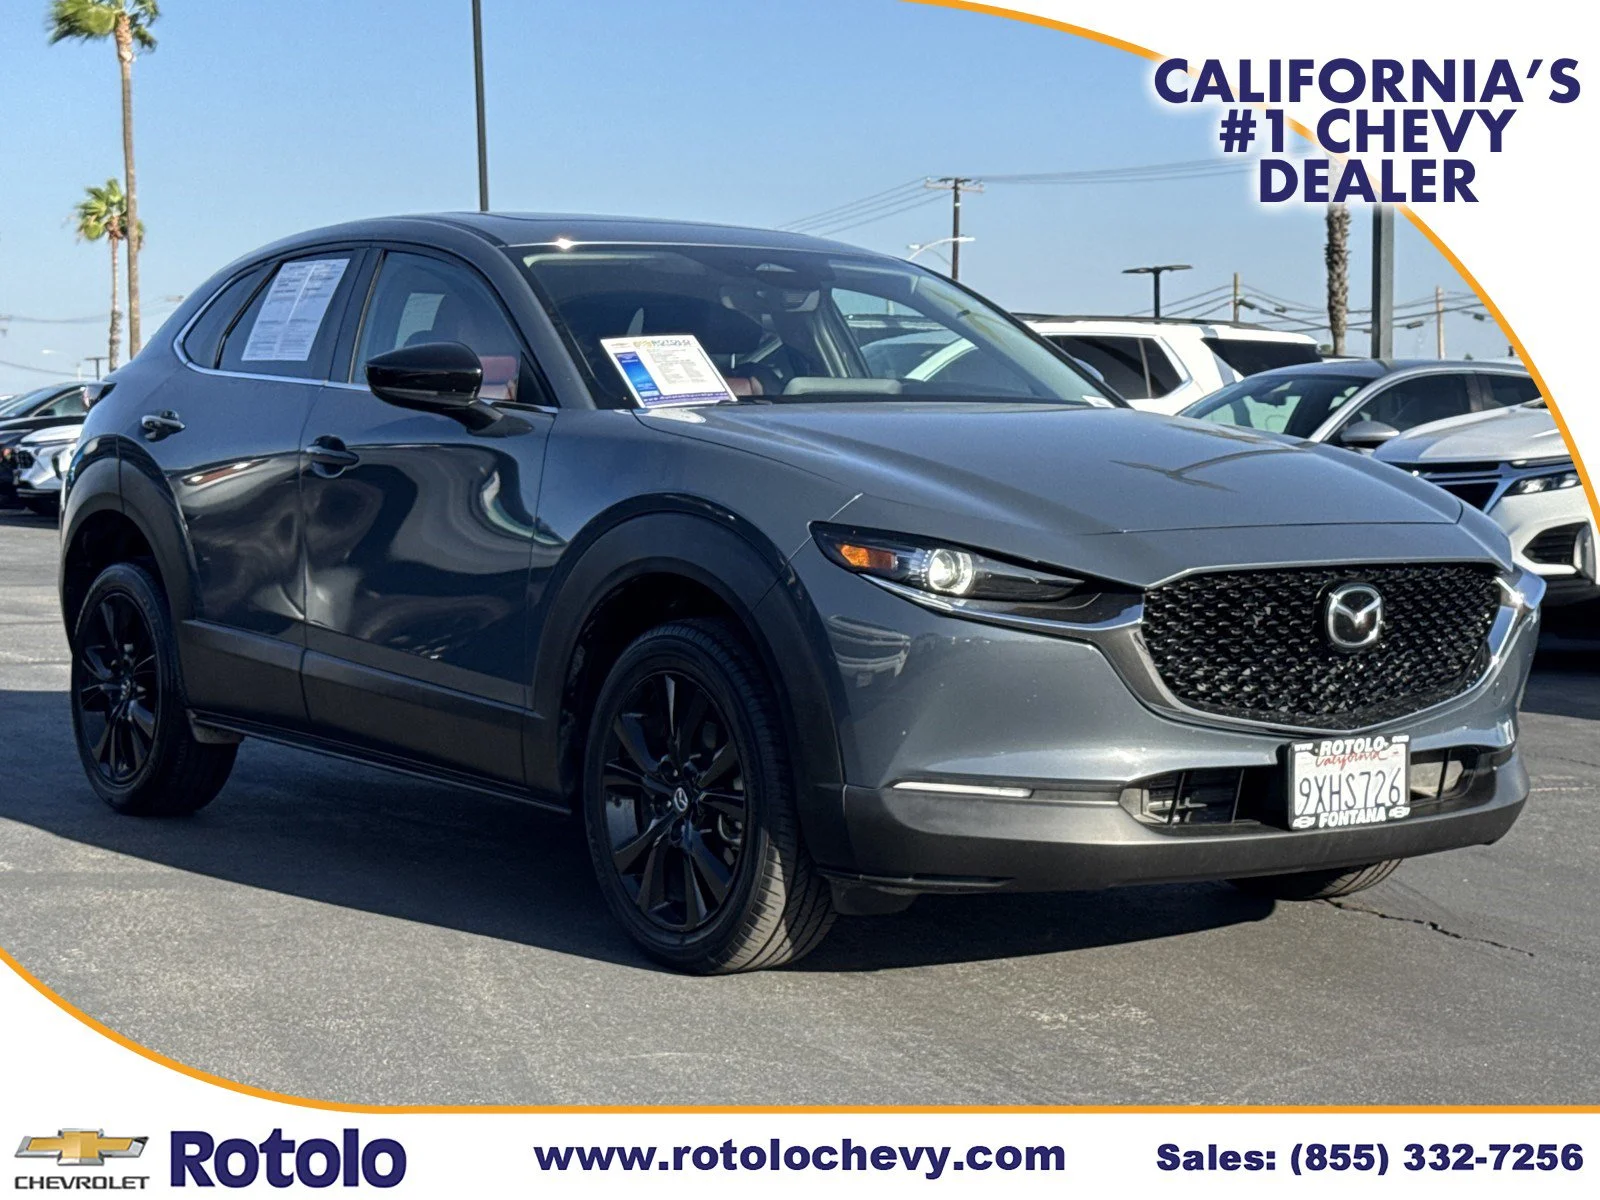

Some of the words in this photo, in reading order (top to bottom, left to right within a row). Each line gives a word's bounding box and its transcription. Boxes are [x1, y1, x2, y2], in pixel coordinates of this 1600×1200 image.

[1319, 736, 1386, 756] ROTOLO
[1299, 767, 1402, 815] 9XHS726
[1318, 807, 1386, 828] FONTANA
